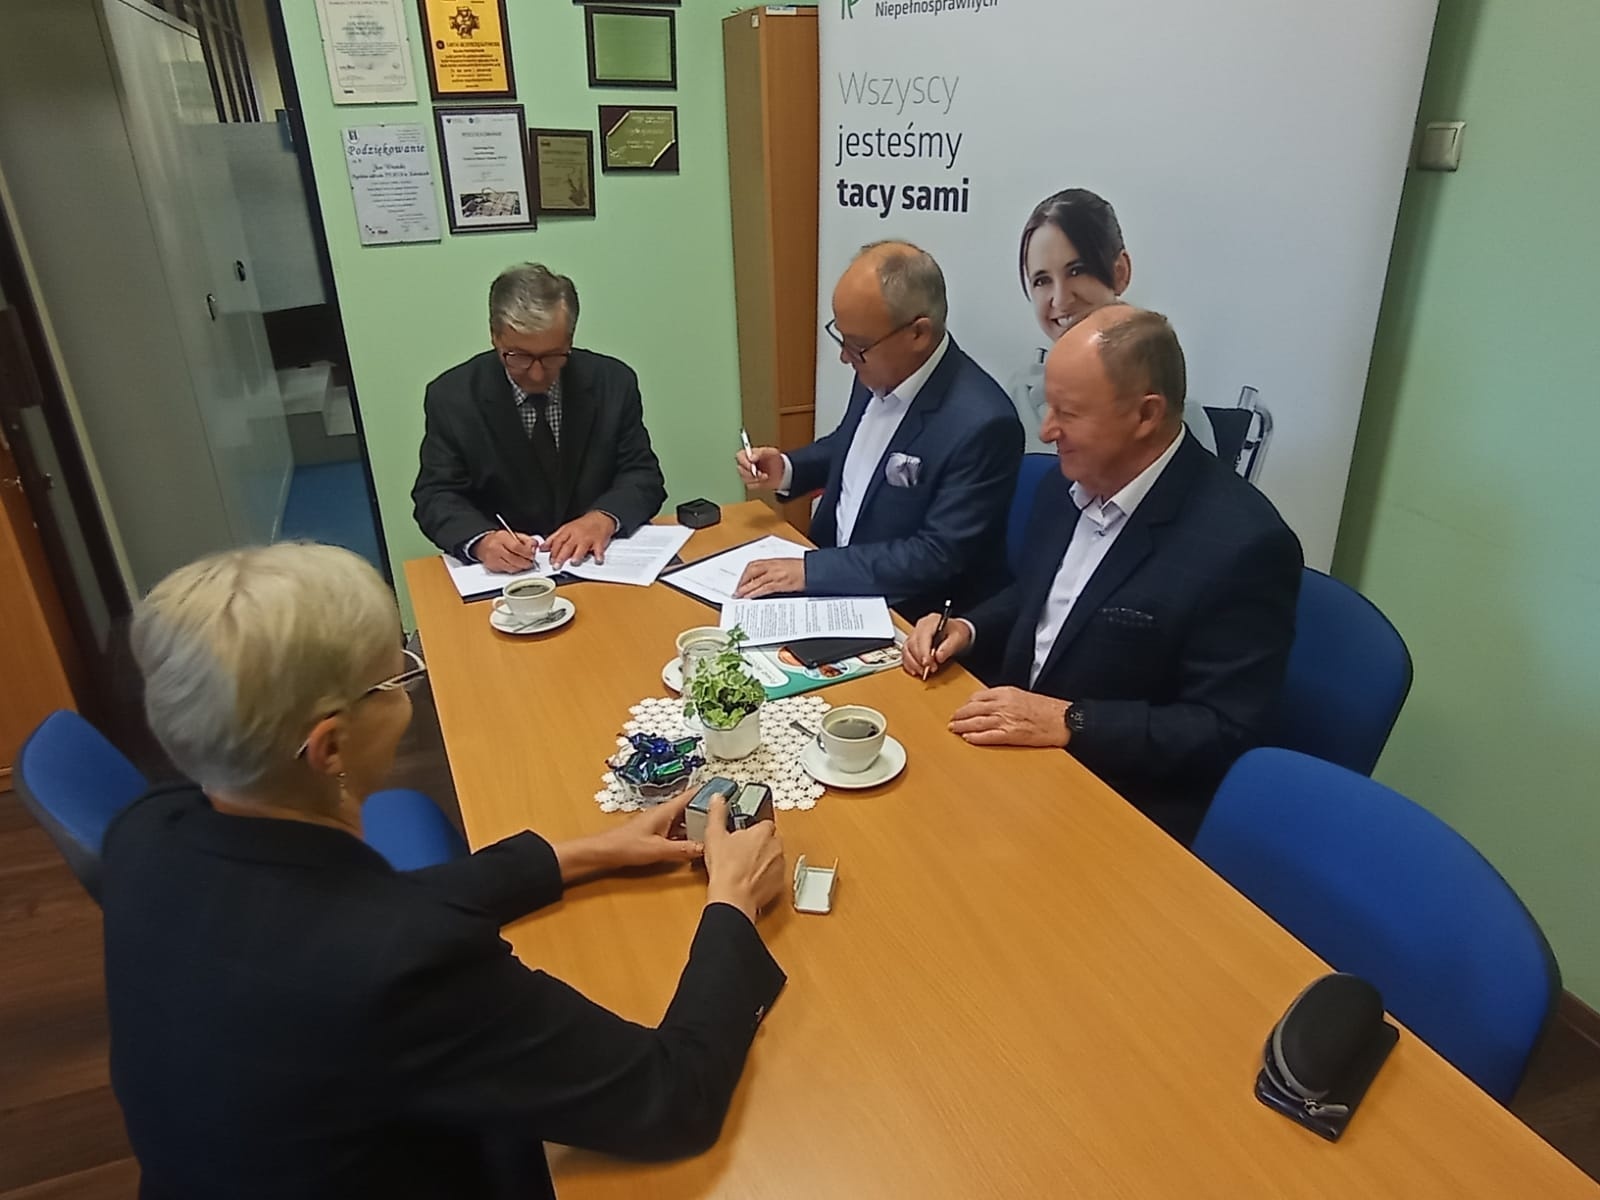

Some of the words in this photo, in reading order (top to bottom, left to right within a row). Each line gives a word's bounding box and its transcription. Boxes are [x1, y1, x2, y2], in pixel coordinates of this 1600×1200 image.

[838, 71, 960, 115] Wszyscy
[347, 143, 425, 156] Podziękowanie
[835, 121, 963, 169] jesteśmy
[836, 178, 896, 219] tacy
[901, 177, 970, 213] sami
